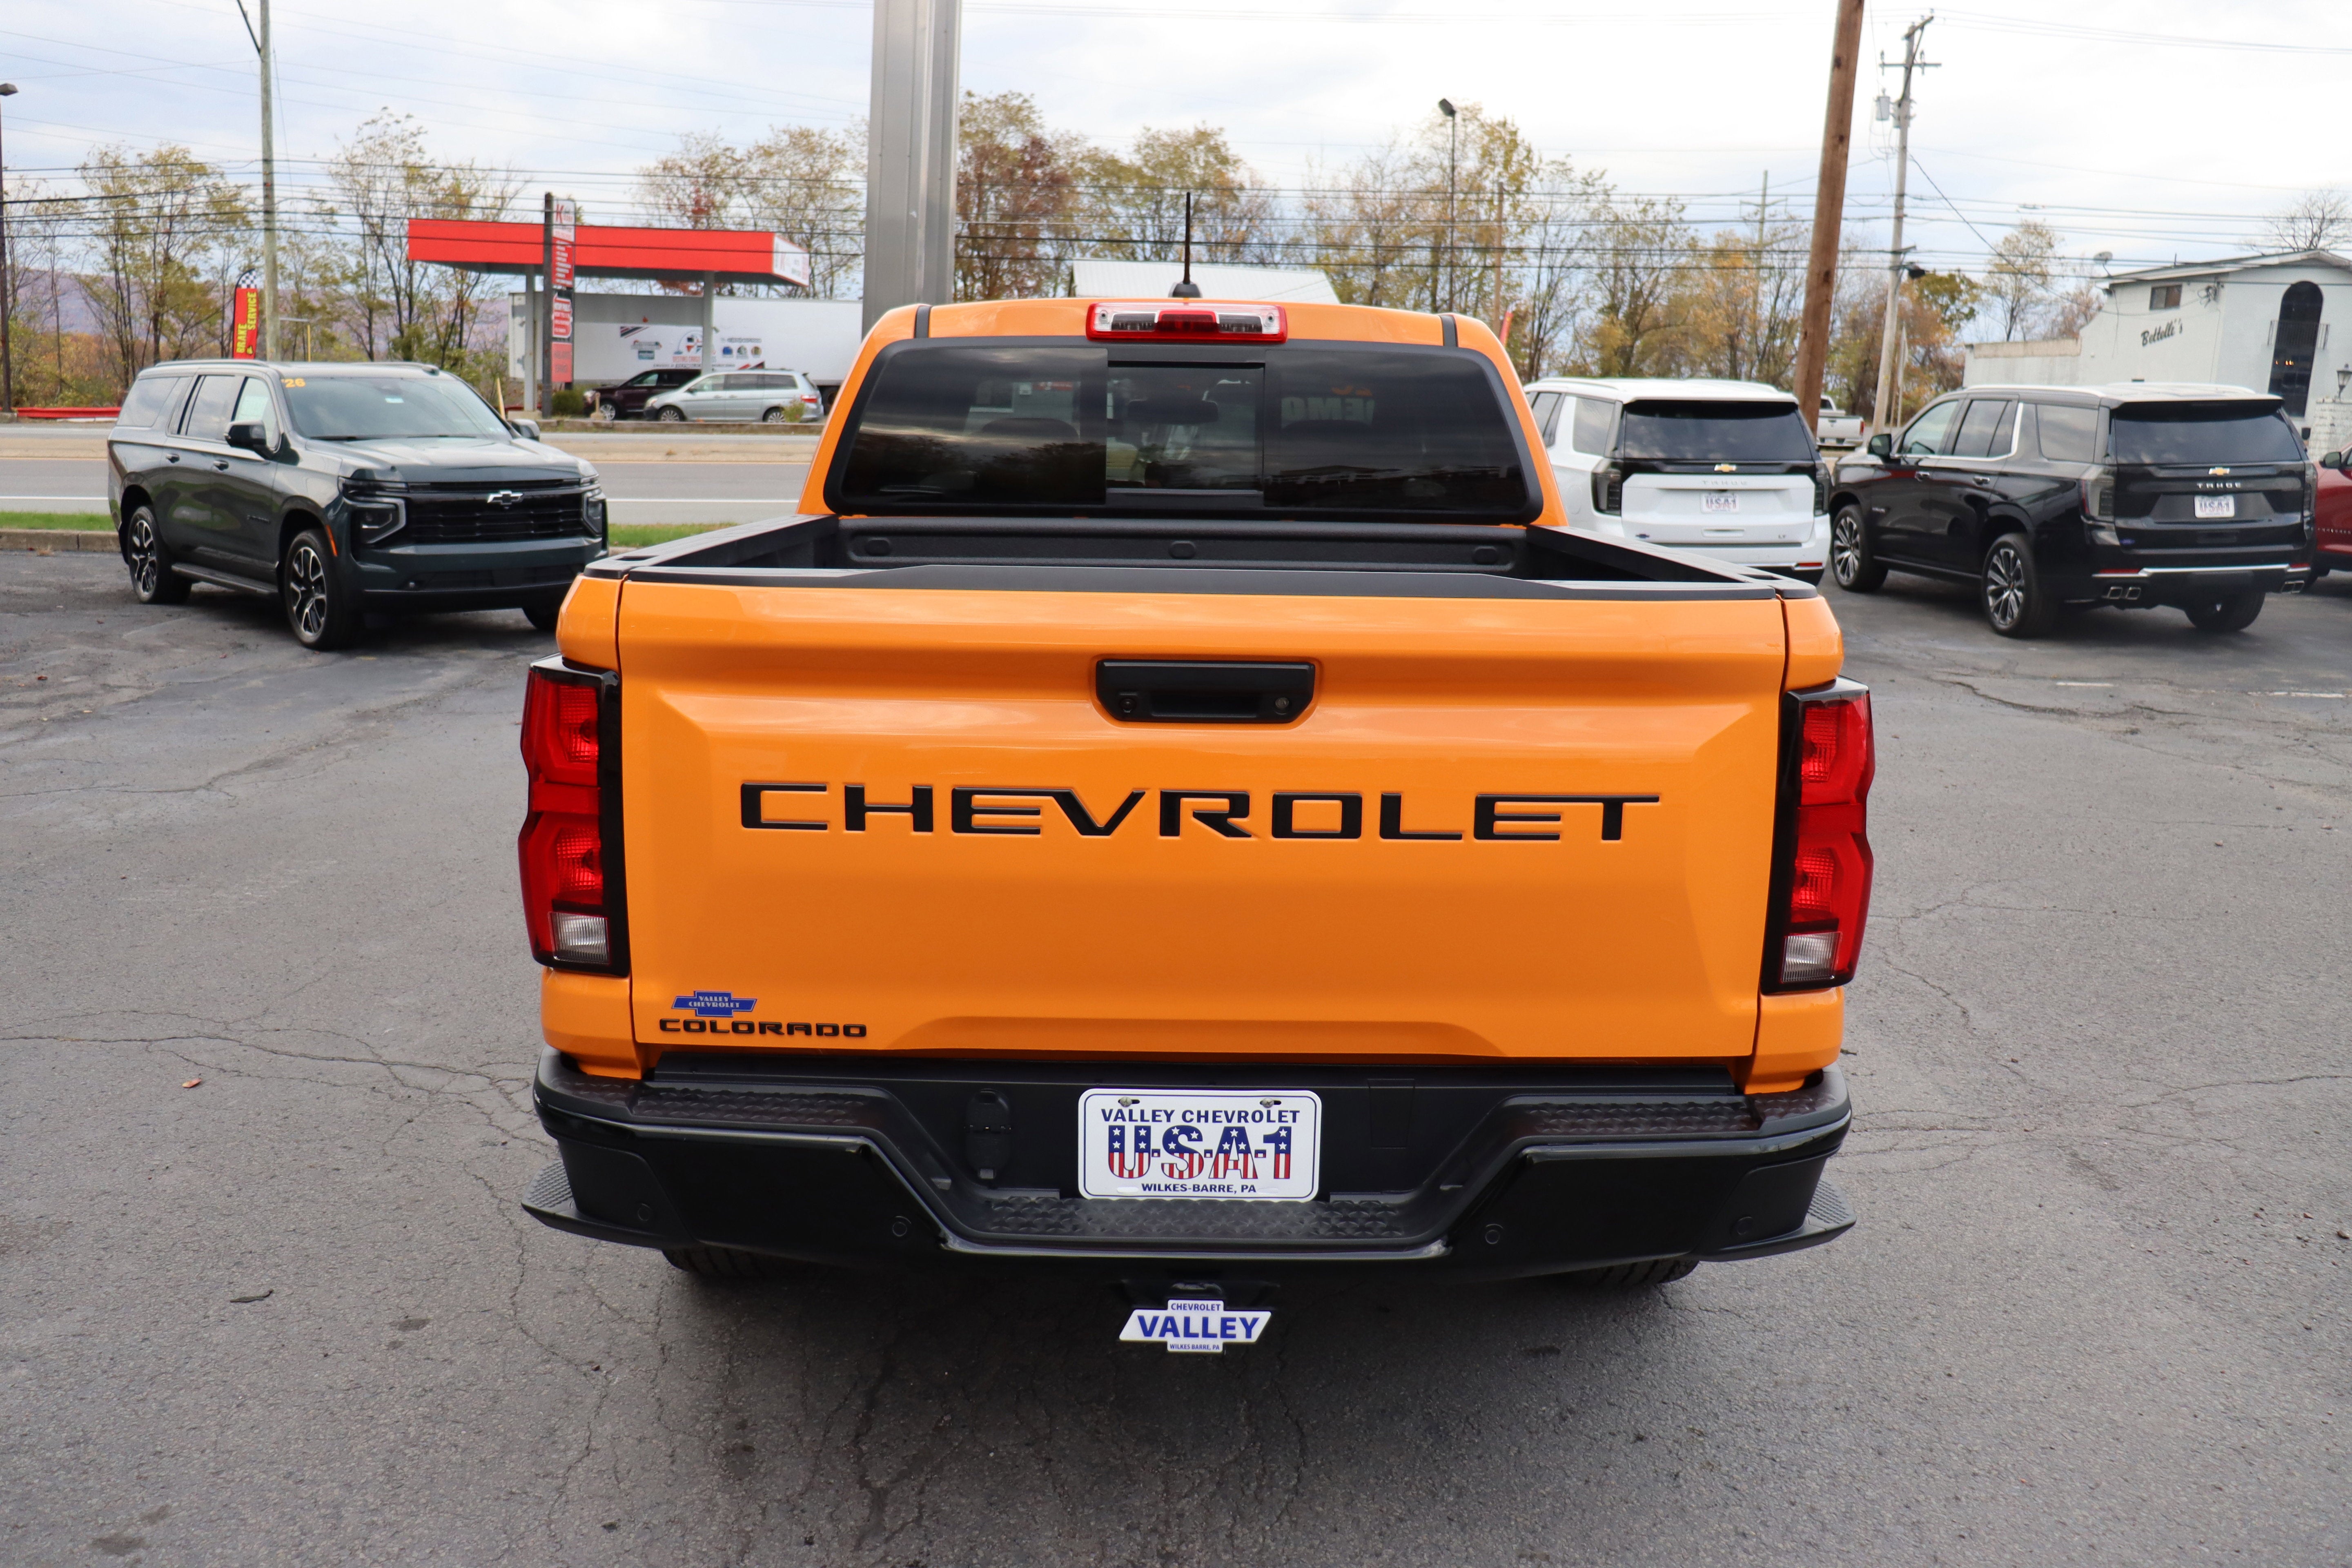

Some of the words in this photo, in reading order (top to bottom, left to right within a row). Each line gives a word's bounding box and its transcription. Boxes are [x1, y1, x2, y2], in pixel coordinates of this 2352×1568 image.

[247, 291, 257, 330] SERVICE
[236, 323, 247, 354] BRAKE
[281, 378, 305, 388] '26
[740, 782, 1661, 841] CHEVROLET
[659, 1018, 867, 1037] COLORADO
[1101, 1108, 1175, 1122] VALLEY
[1181, 1109, 1300, 1123] CHEVROLET
[1108, 1125, 1292, 1179] U-S-A-1
[1142, 1183, 1237, 1194] WILKES-BARRE,
[1241, 1184, 1256, 1193] PA
[1171, 1303, 1221, 1311] CHEVROLET
[1137, 1315, 1260, 1339] VALLEY
